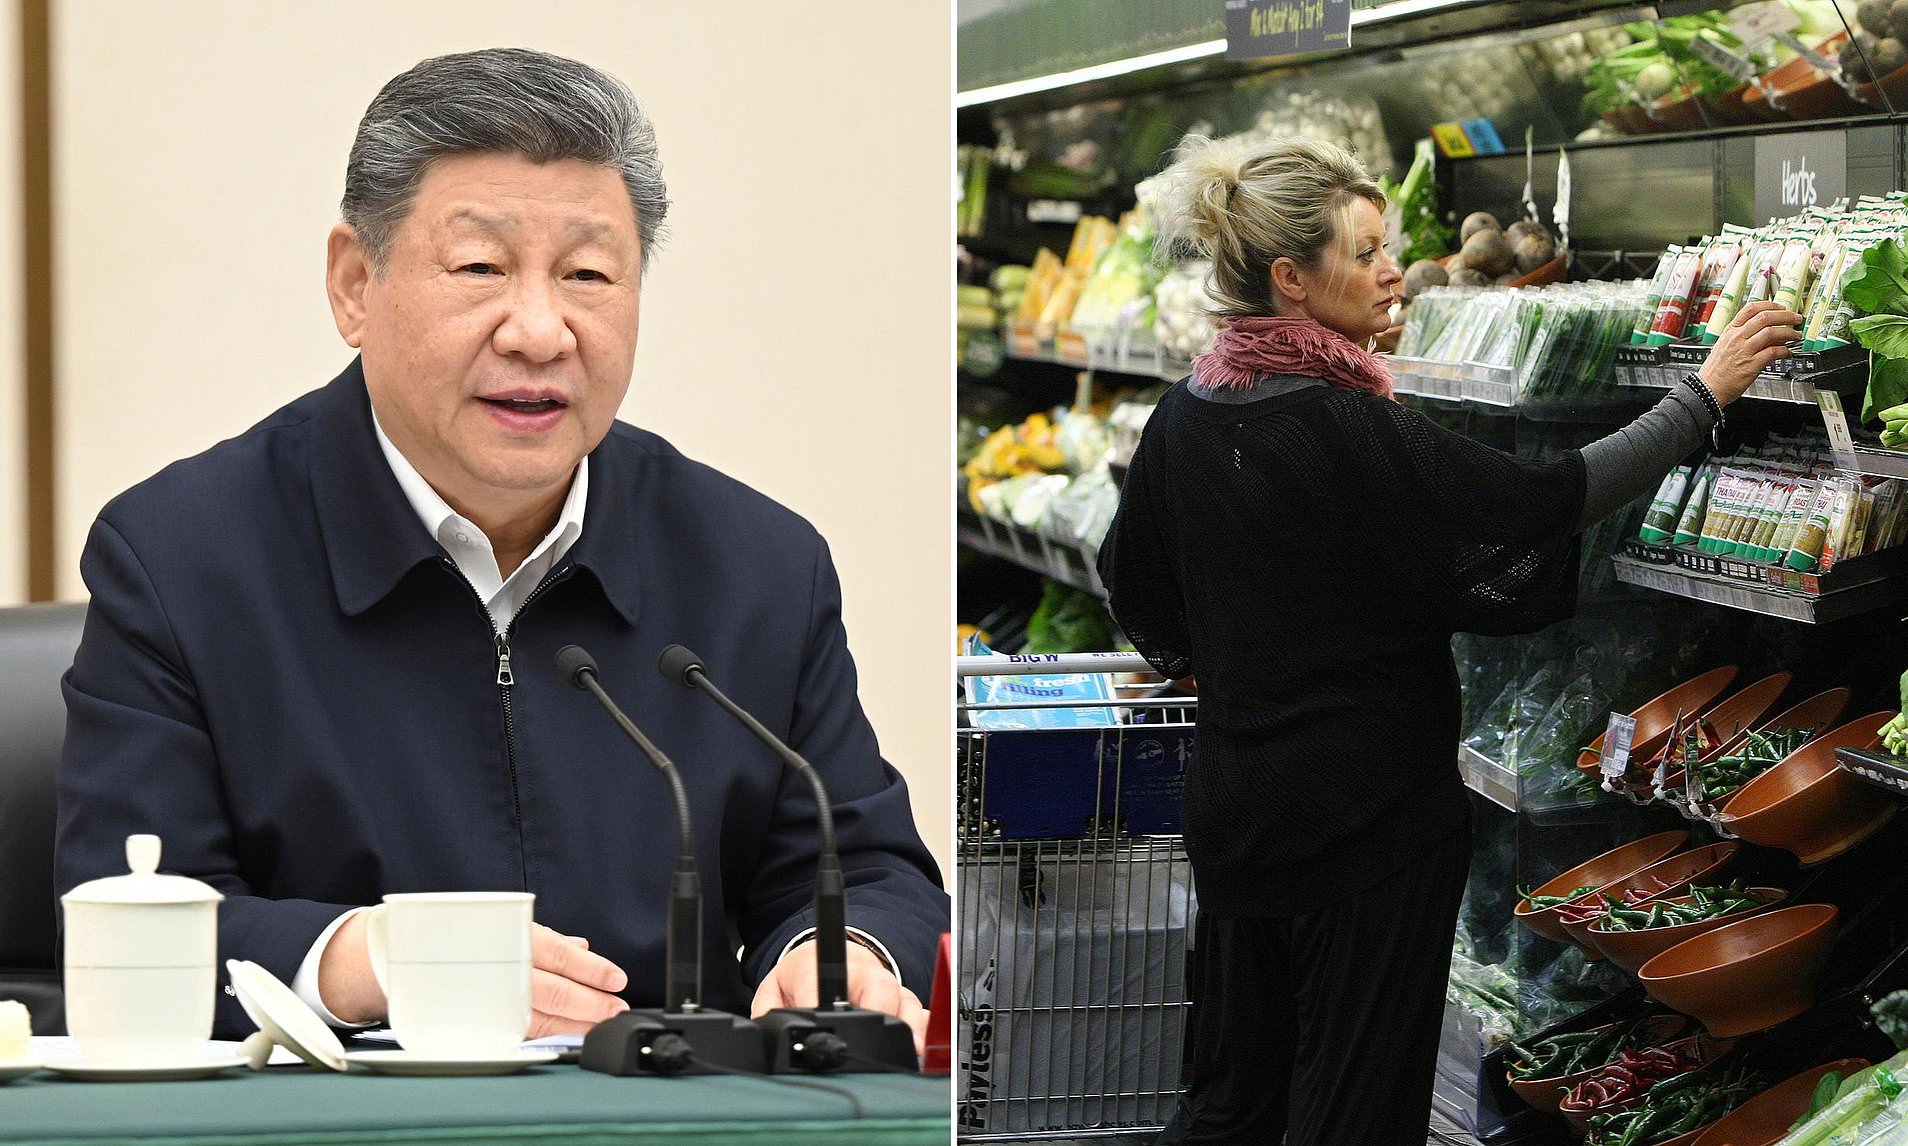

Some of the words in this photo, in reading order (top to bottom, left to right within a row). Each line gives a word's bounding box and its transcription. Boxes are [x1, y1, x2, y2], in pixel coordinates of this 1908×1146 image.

[1782, 155, 1817, 205] Herbs
[1009, 654, 1041, 663] BIG
[1046, 653, 1059, 662] W
